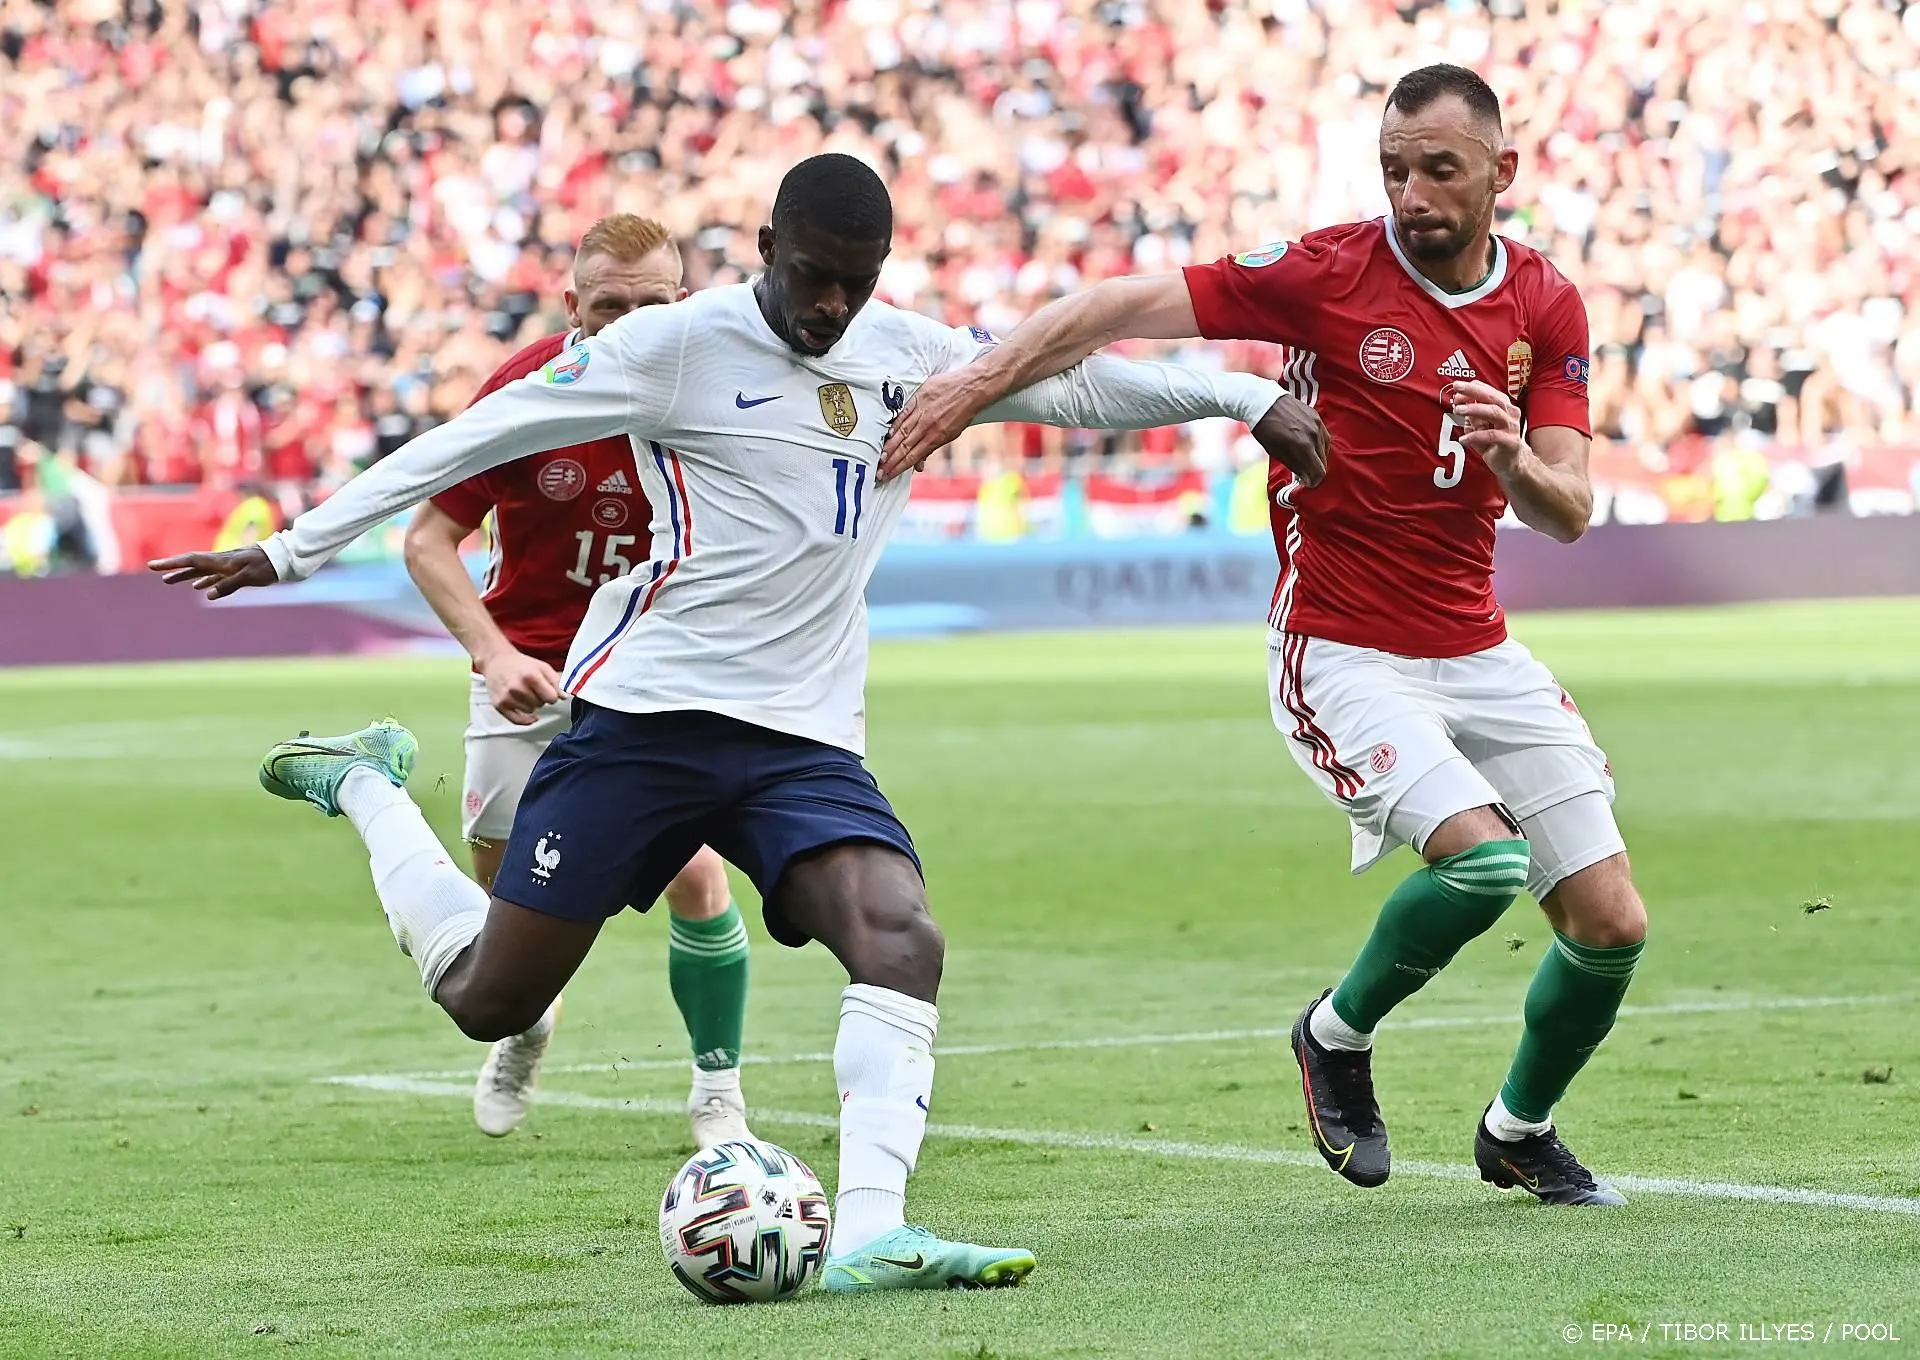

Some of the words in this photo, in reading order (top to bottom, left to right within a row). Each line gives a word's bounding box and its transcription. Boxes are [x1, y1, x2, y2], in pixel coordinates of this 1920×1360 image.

[1437, 366, 1476, 378] adidas
[834, 416, 850, 425] FIFA
[1433, 413, 1466, 489] 5
[596, 484, 633, 495] adidas
[832, 458, 867, 540] 11
[566, 530, 636, 587] 15
[1056, 559, 1253, 609] QATAR
